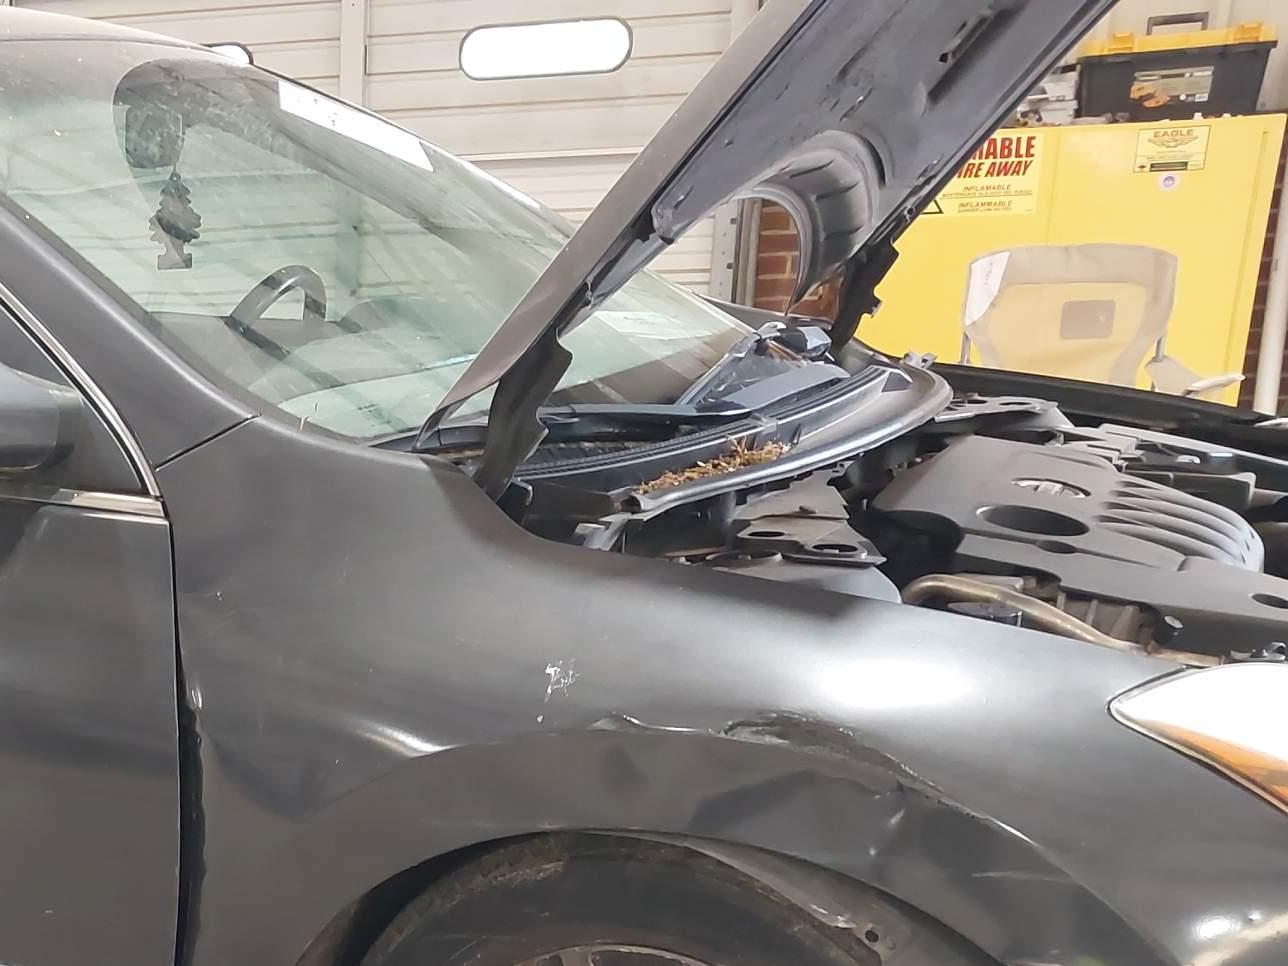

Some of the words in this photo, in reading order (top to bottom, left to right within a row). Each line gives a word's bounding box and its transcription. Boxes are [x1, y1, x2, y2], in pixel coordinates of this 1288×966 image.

[1153, 128, 1195, 139] EAGLE
[957, 162, 985, 179] IRE
[984, 160, 1033, 178] AWAY
